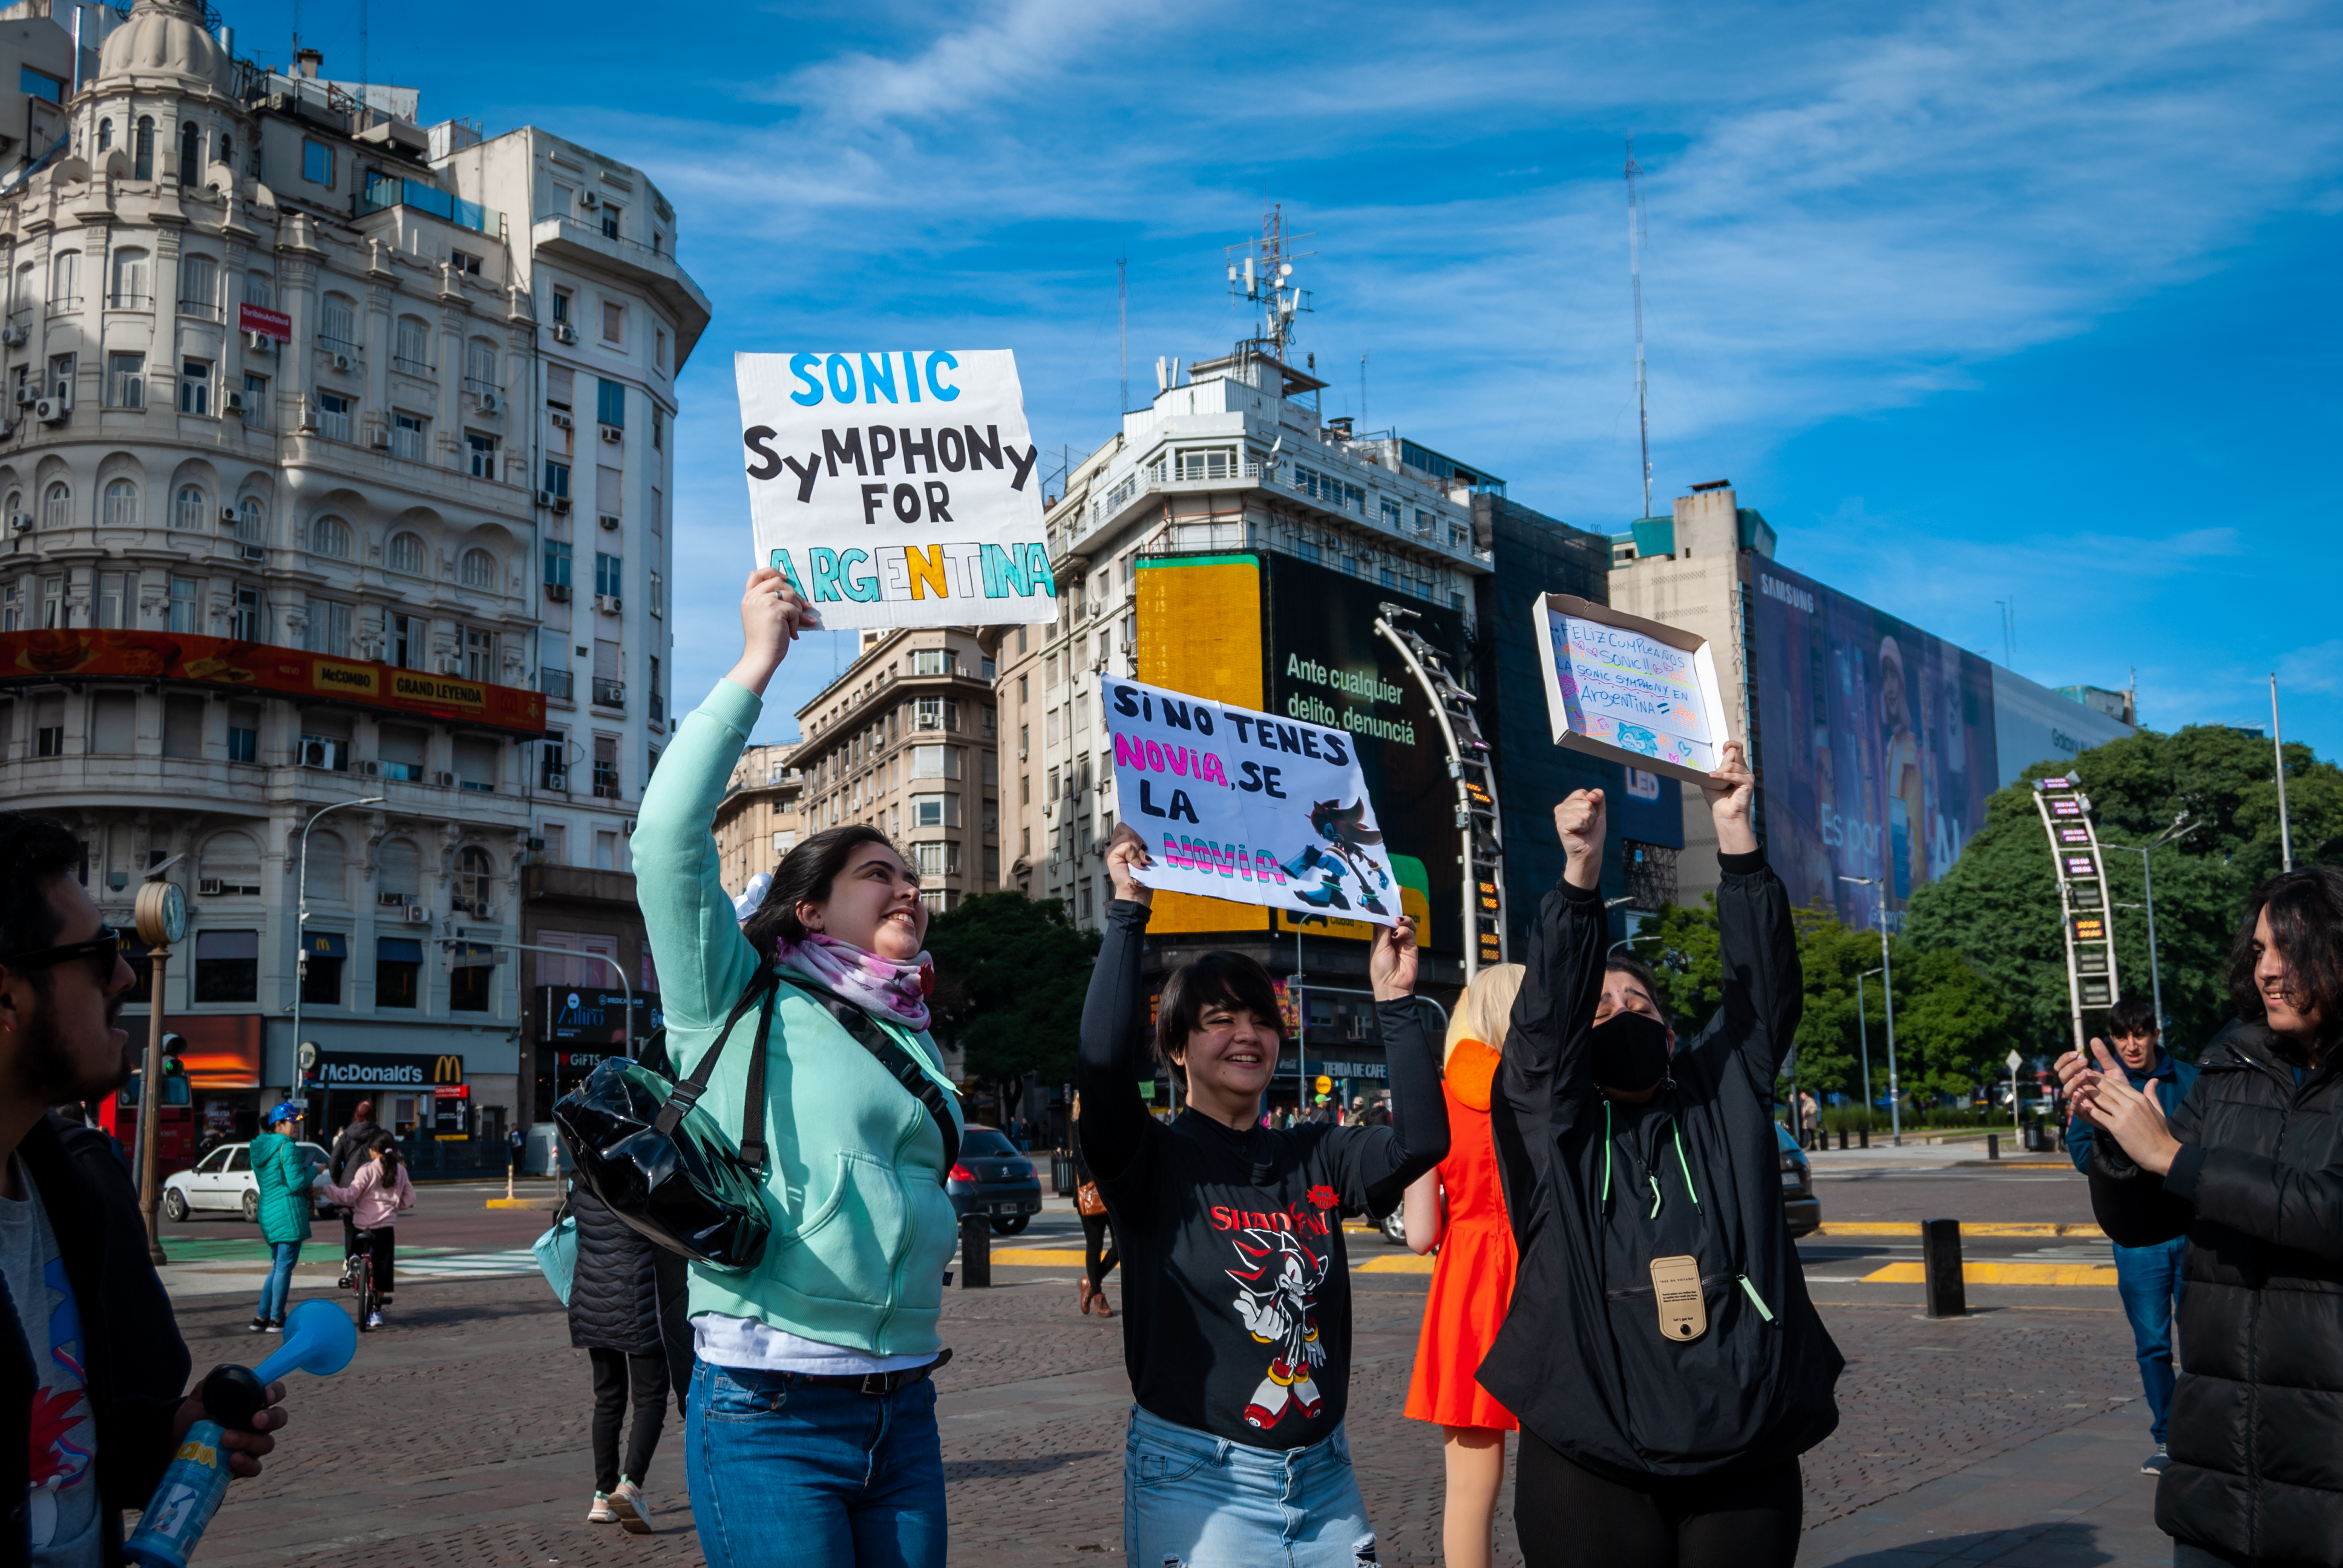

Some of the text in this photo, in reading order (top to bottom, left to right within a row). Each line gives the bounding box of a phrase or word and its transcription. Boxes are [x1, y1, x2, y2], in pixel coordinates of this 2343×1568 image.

[790, 350, 960, 406] SONIC
[861, 481, 954, 524] FOR
[770, 542, 1056, 603] ARGENTINA
[1760, 573, 1814, 613] SAMSUNG
[321, 667, 371, 688] McCOMBO
[396, 678, 482, 704] GRAND LEYENDA
[1286, 653, 1403, 705] Ante cualquier
[1555, 656, 1573, 673] LA
[1673, 689, 1688, 702] EN
[1161, 697, 1215, 736] NO
[1224, 711, 1350, 766] TENES
[1288, 691, 1416, 746] delito, denunciá
[1139, 779, 1200, 824] LA
[1238, 760, 1288, 800] SE
[1821, 803, 1844, 848] Es
[1847, 818, 1882, 865] por
[319, 1063, 424, 1083] McDonald's
[1322, 1061, 1353, 1078] TIENDA
[1353, 1063, 1365, 1078] DE
